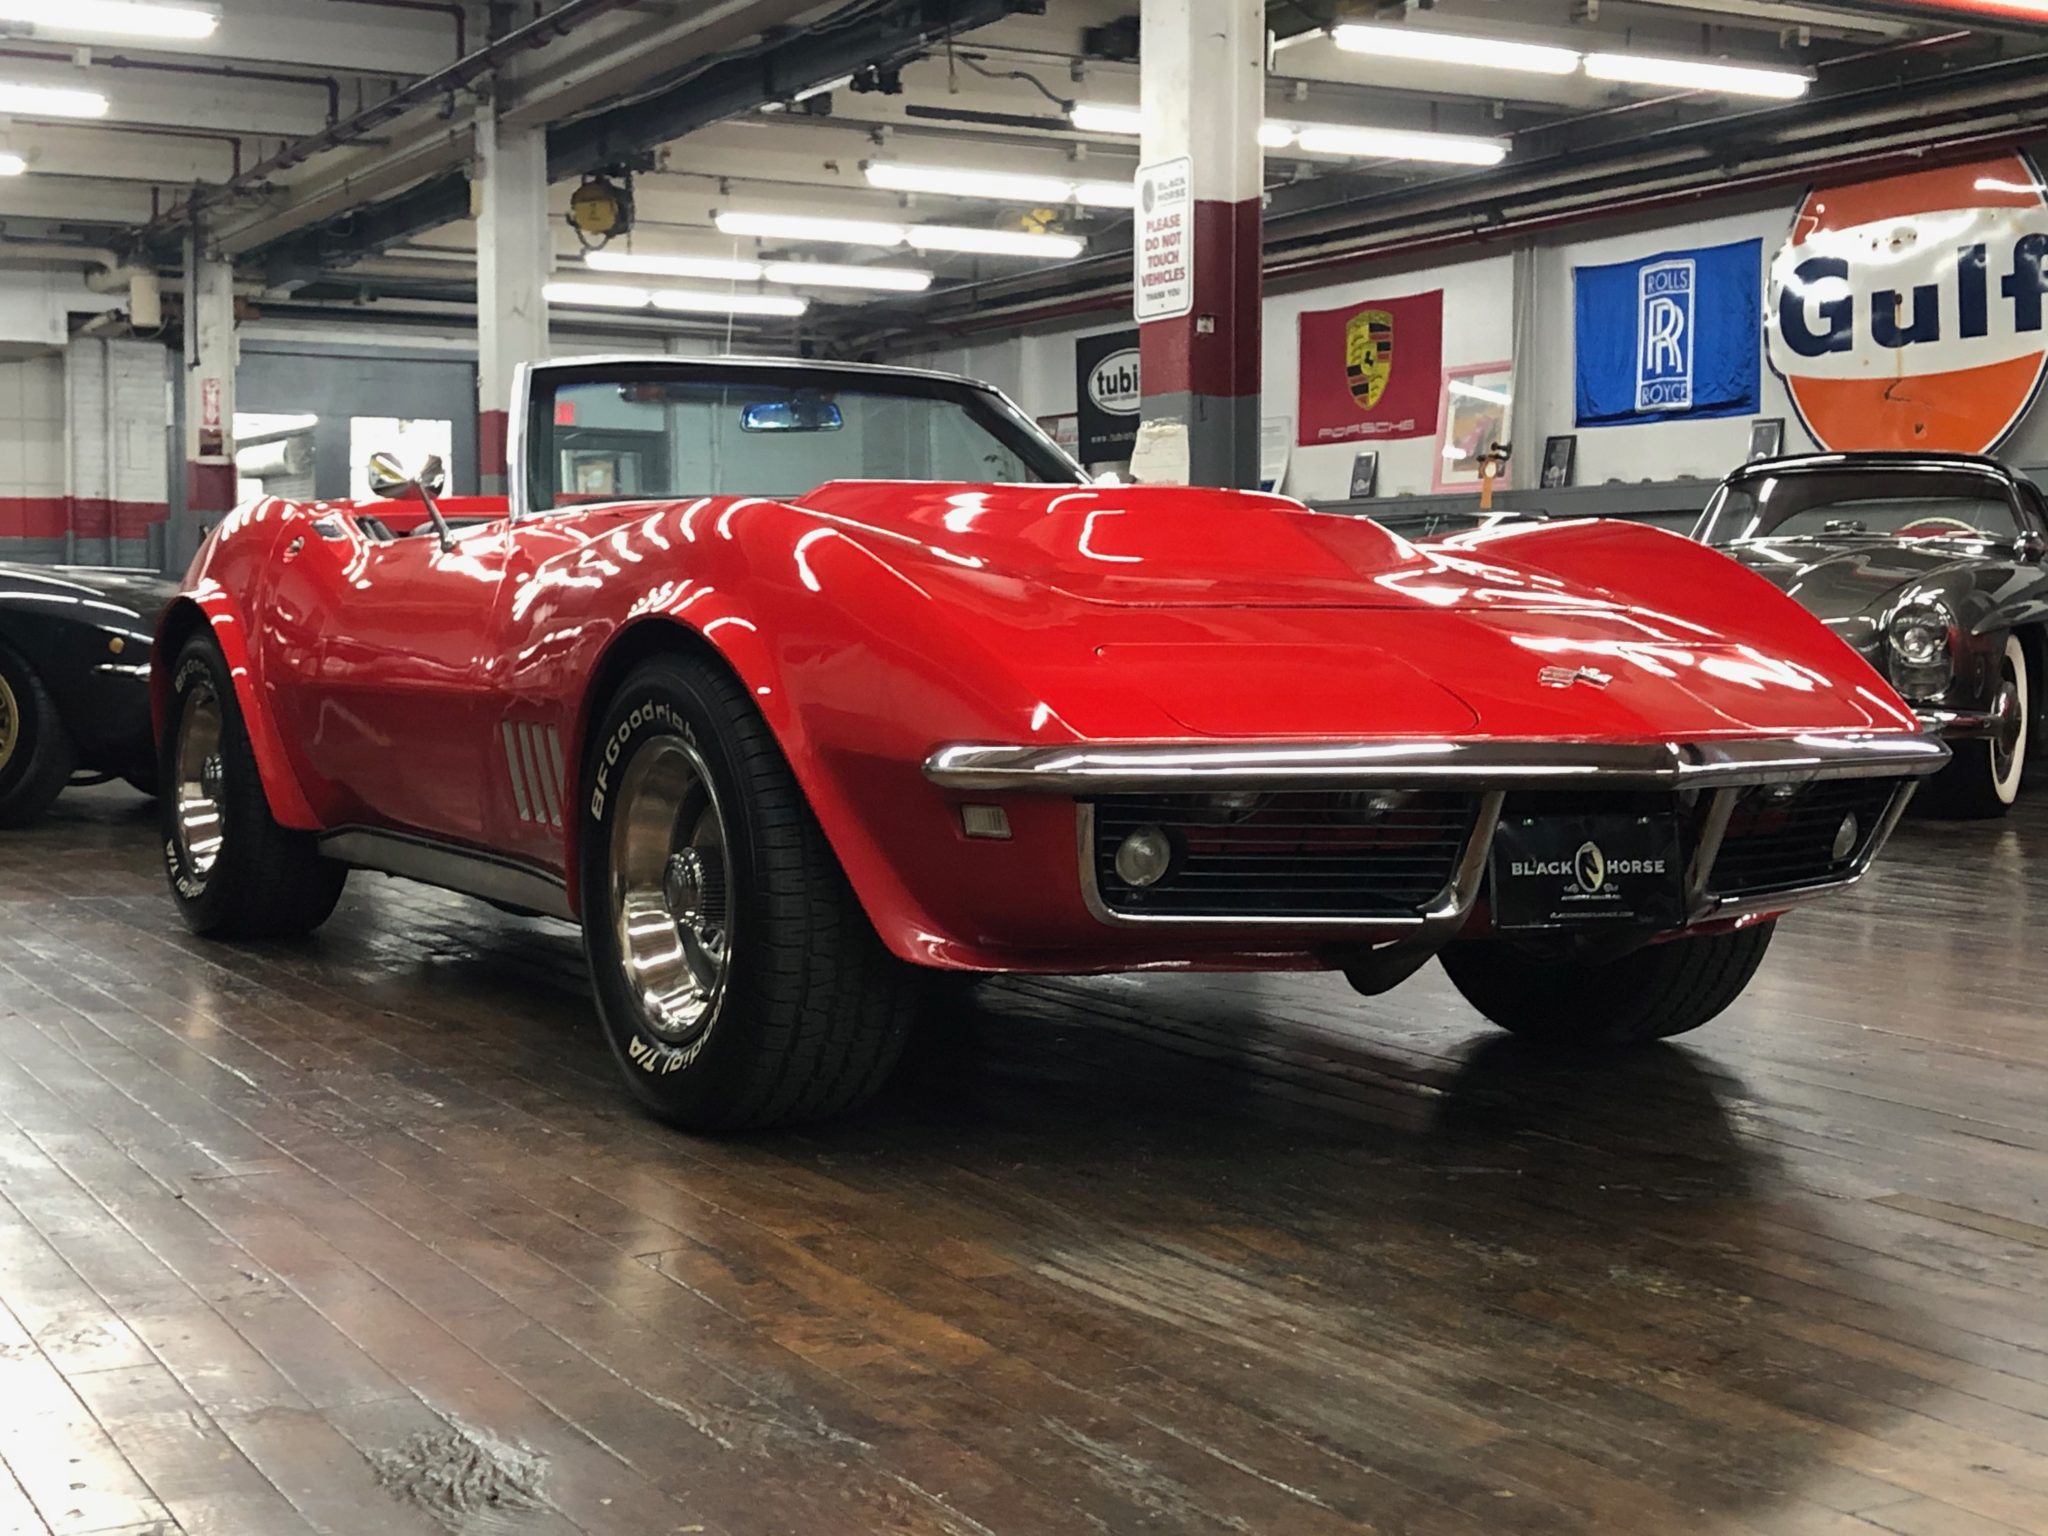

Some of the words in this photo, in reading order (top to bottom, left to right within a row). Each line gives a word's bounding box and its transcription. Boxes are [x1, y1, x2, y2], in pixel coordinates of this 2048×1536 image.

[1157, 177, 1186, 191] BLACK
[1157, 188, 1186, 202] HORSE
[1146, 214, 1181, 232] PLEASE
[1145, 238, 1159, 251] DO
[1162, 232, 1182, 247] NOT
[1147, 251, 1179, 268] TOUCH
[1141, 267, 1185, 287] VEHICLES
[1647, 270, 1688, 293] ROLLS
[1146, 290, 1166, 301] THANK
[1167, 288, 1181, 297] YOU
[1779, 233, 2048, 357] Gulf
[1097, 364, 1138, 396] tubi
[1641, 383, 1687, 404] ROYCE
[1318, 419, 1415, 438] PORSCHE
[1511, 861, 1573, 876] BLACK
[1606, 860, 1665, 874] HORSE
[628, 1034, 660, 1072] T/A
